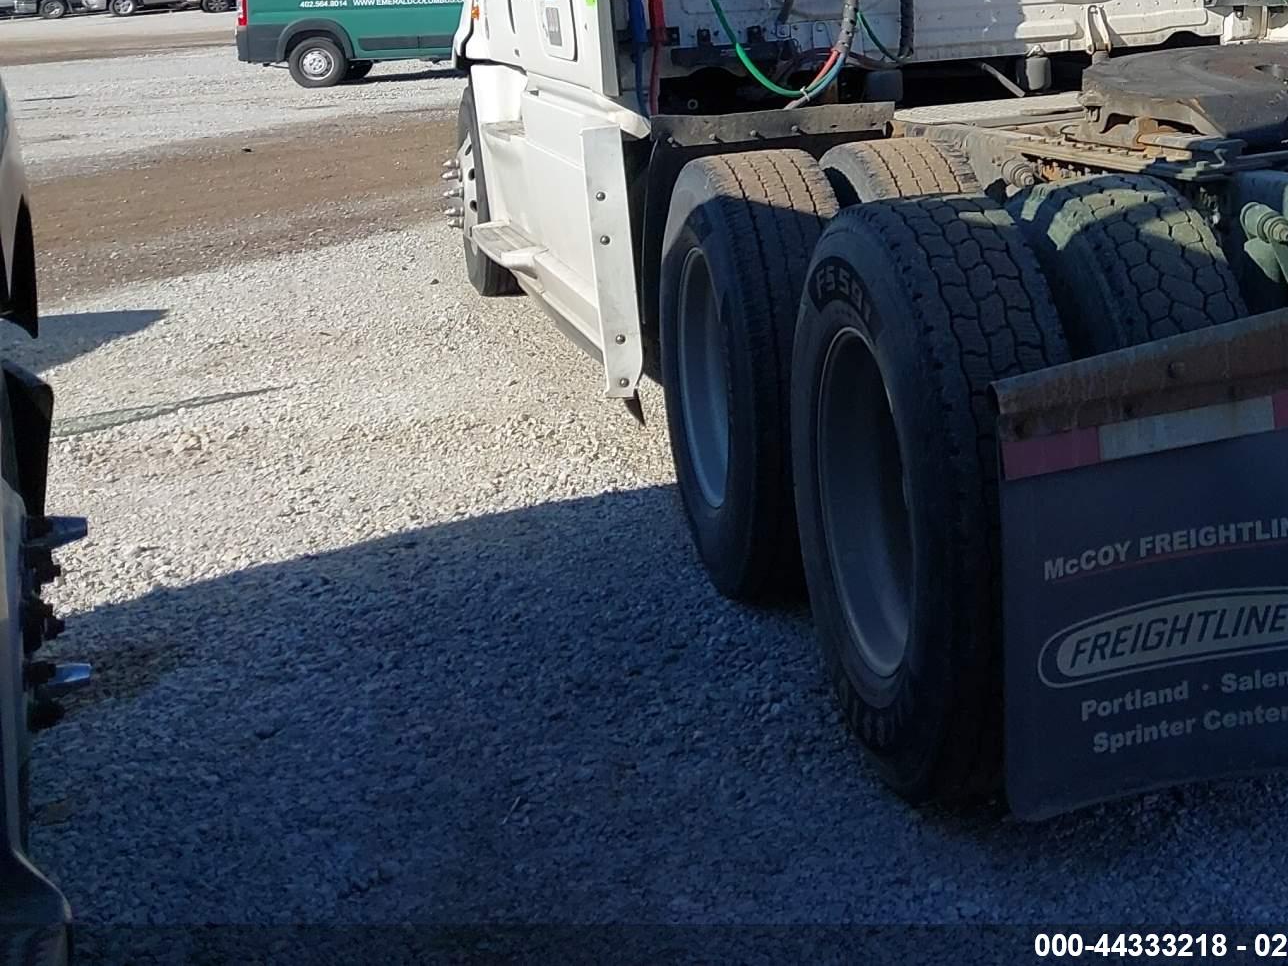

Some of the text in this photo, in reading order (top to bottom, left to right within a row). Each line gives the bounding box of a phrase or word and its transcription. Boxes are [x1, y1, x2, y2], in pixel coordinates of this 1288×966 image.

[1044, 540, 1132, 581] McCOY
[1081, 680, 1189, 721] Portland
[1093, 715, 1196, 754] Sprinter
